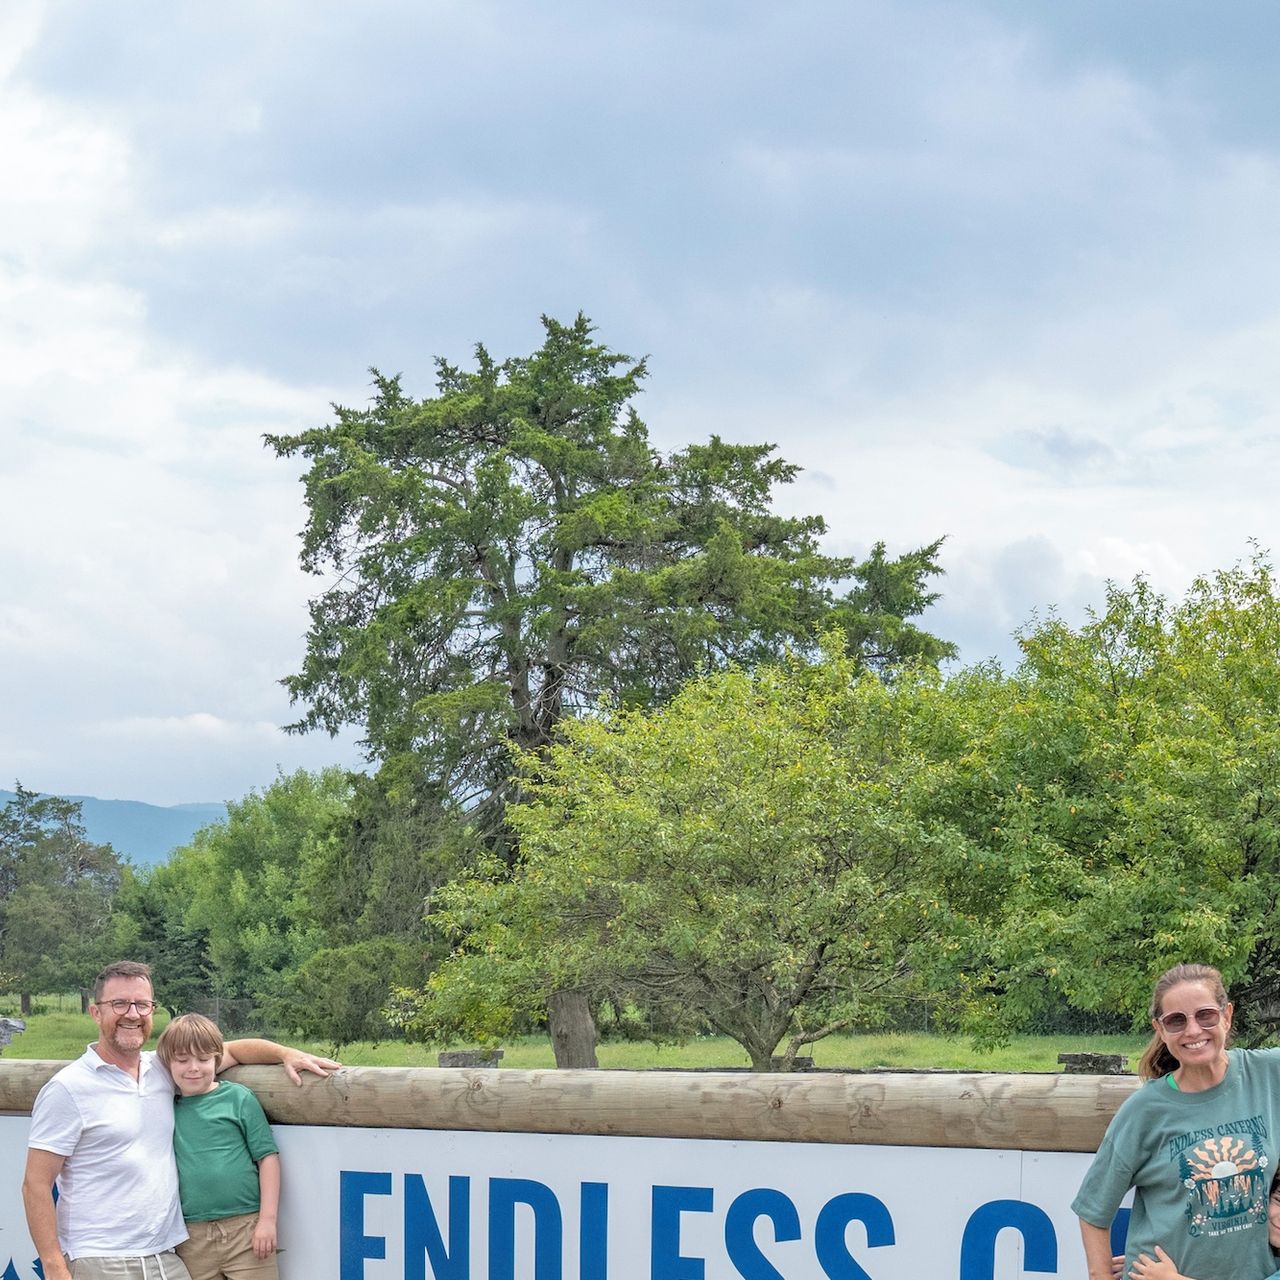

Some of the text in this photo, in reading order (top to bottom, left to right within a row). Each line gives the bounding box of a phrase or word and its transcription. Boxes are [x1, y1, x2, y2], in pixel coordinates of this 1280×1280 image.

[1169, 1115, 1267, 1161] ENDLESS CAVERNS
[1212, 1215, 1249, 1230] VIRGINIA
